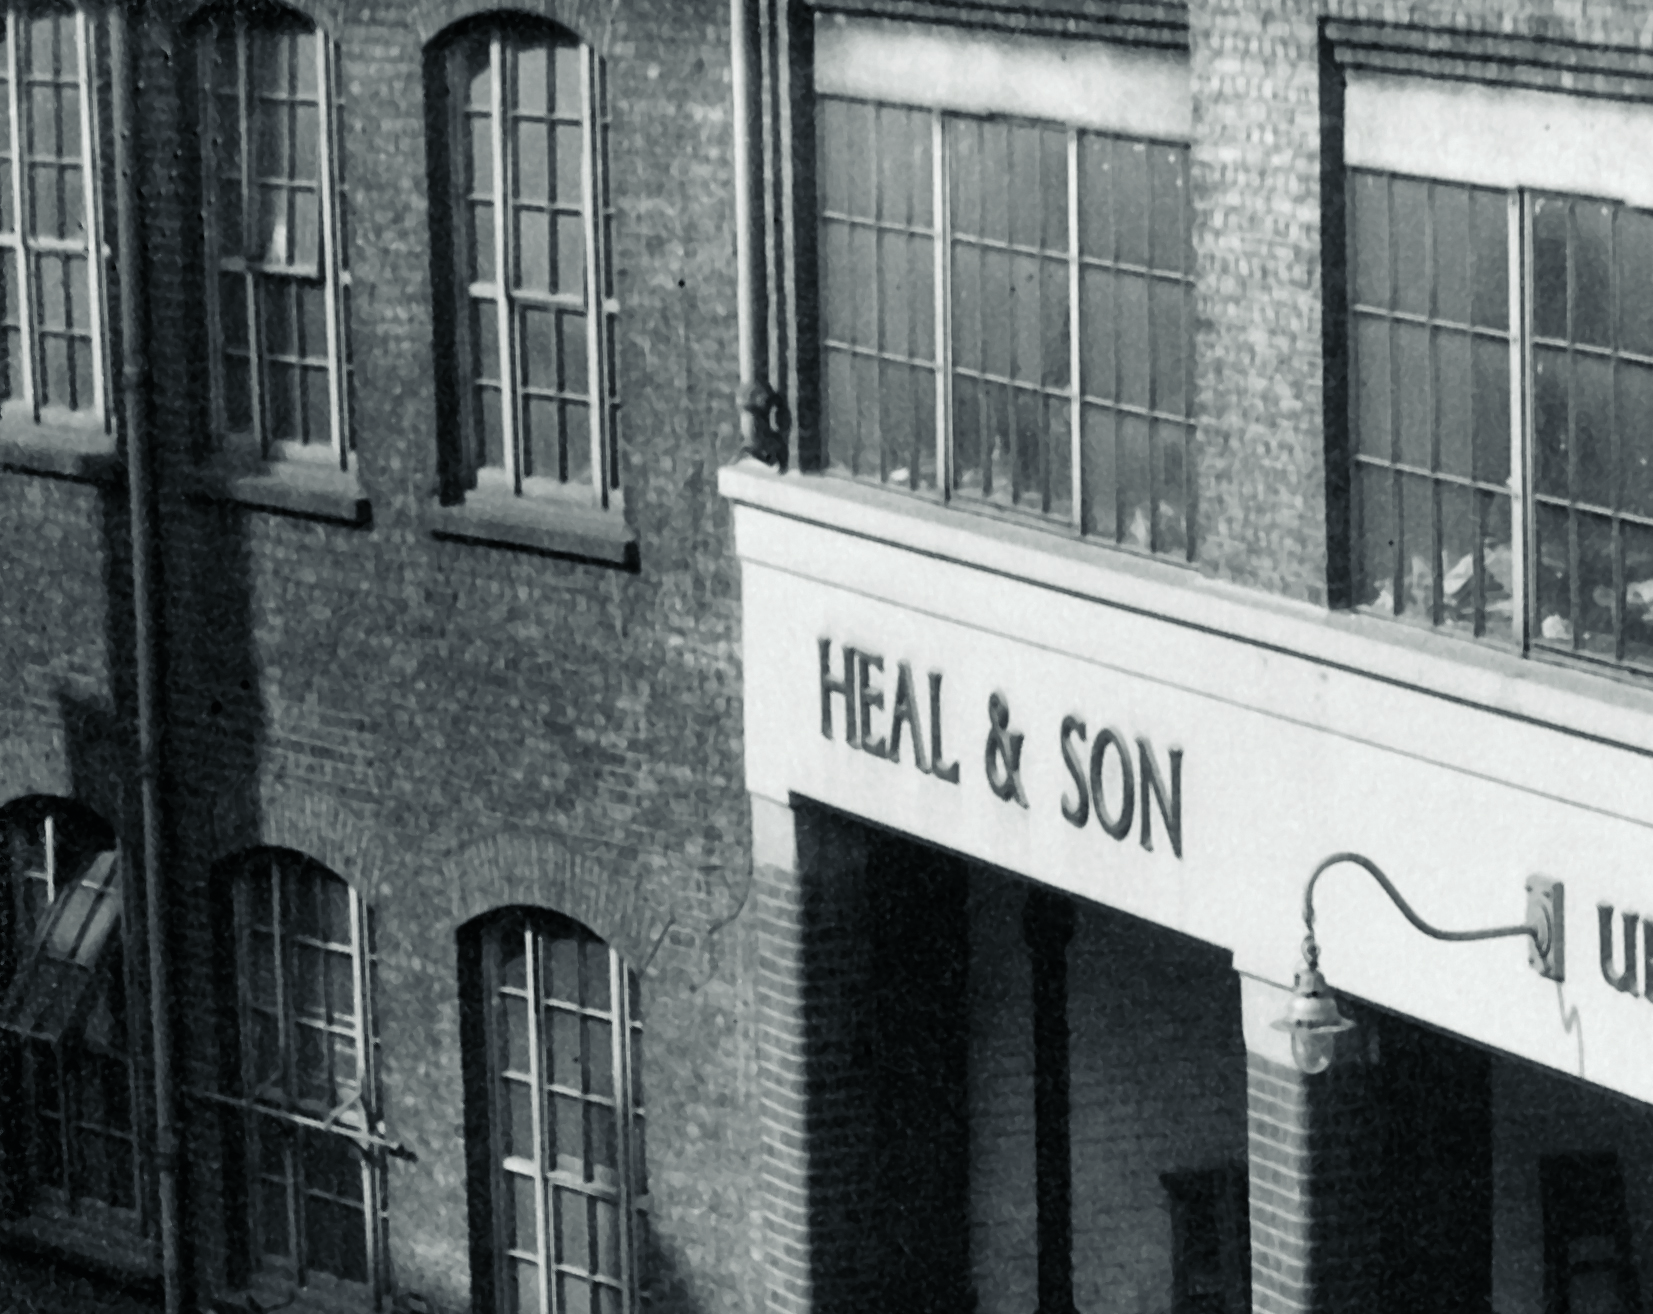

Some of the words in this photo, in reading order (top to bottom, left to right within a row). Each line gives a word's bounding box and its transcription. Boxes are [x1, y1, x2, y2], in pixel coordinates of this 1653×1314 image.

[817, 636, 960, 785] HEAL
[985, 688, 1029, 809] &
[1060, 712, 1185, 860] SON
